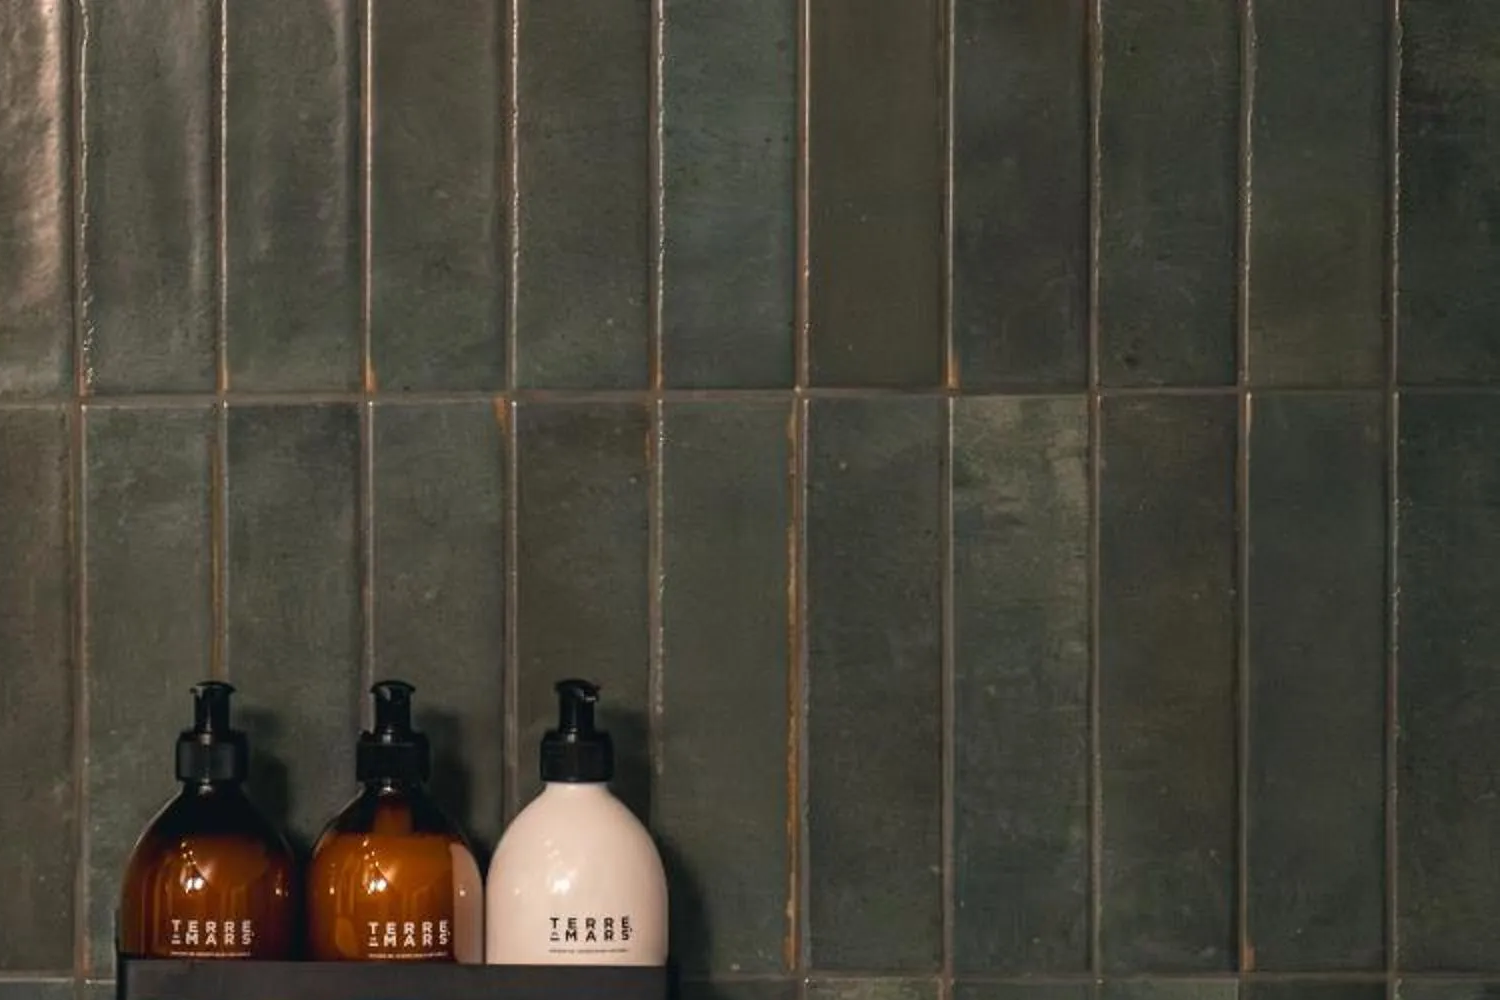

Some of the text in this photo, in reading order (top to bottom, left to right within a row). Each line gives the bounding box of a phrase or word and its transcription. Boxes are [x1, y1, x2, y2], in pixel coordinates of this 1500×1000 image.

[171, 919, 252, 933] TERRE
[368, 920, 449, 934] TERRE
[549, 916, 629, 929] TERRE
[185, 932, 252, 945] MARS
[383, 933, 449, 947] MARS
[565, 929, 630, 942] MARS
